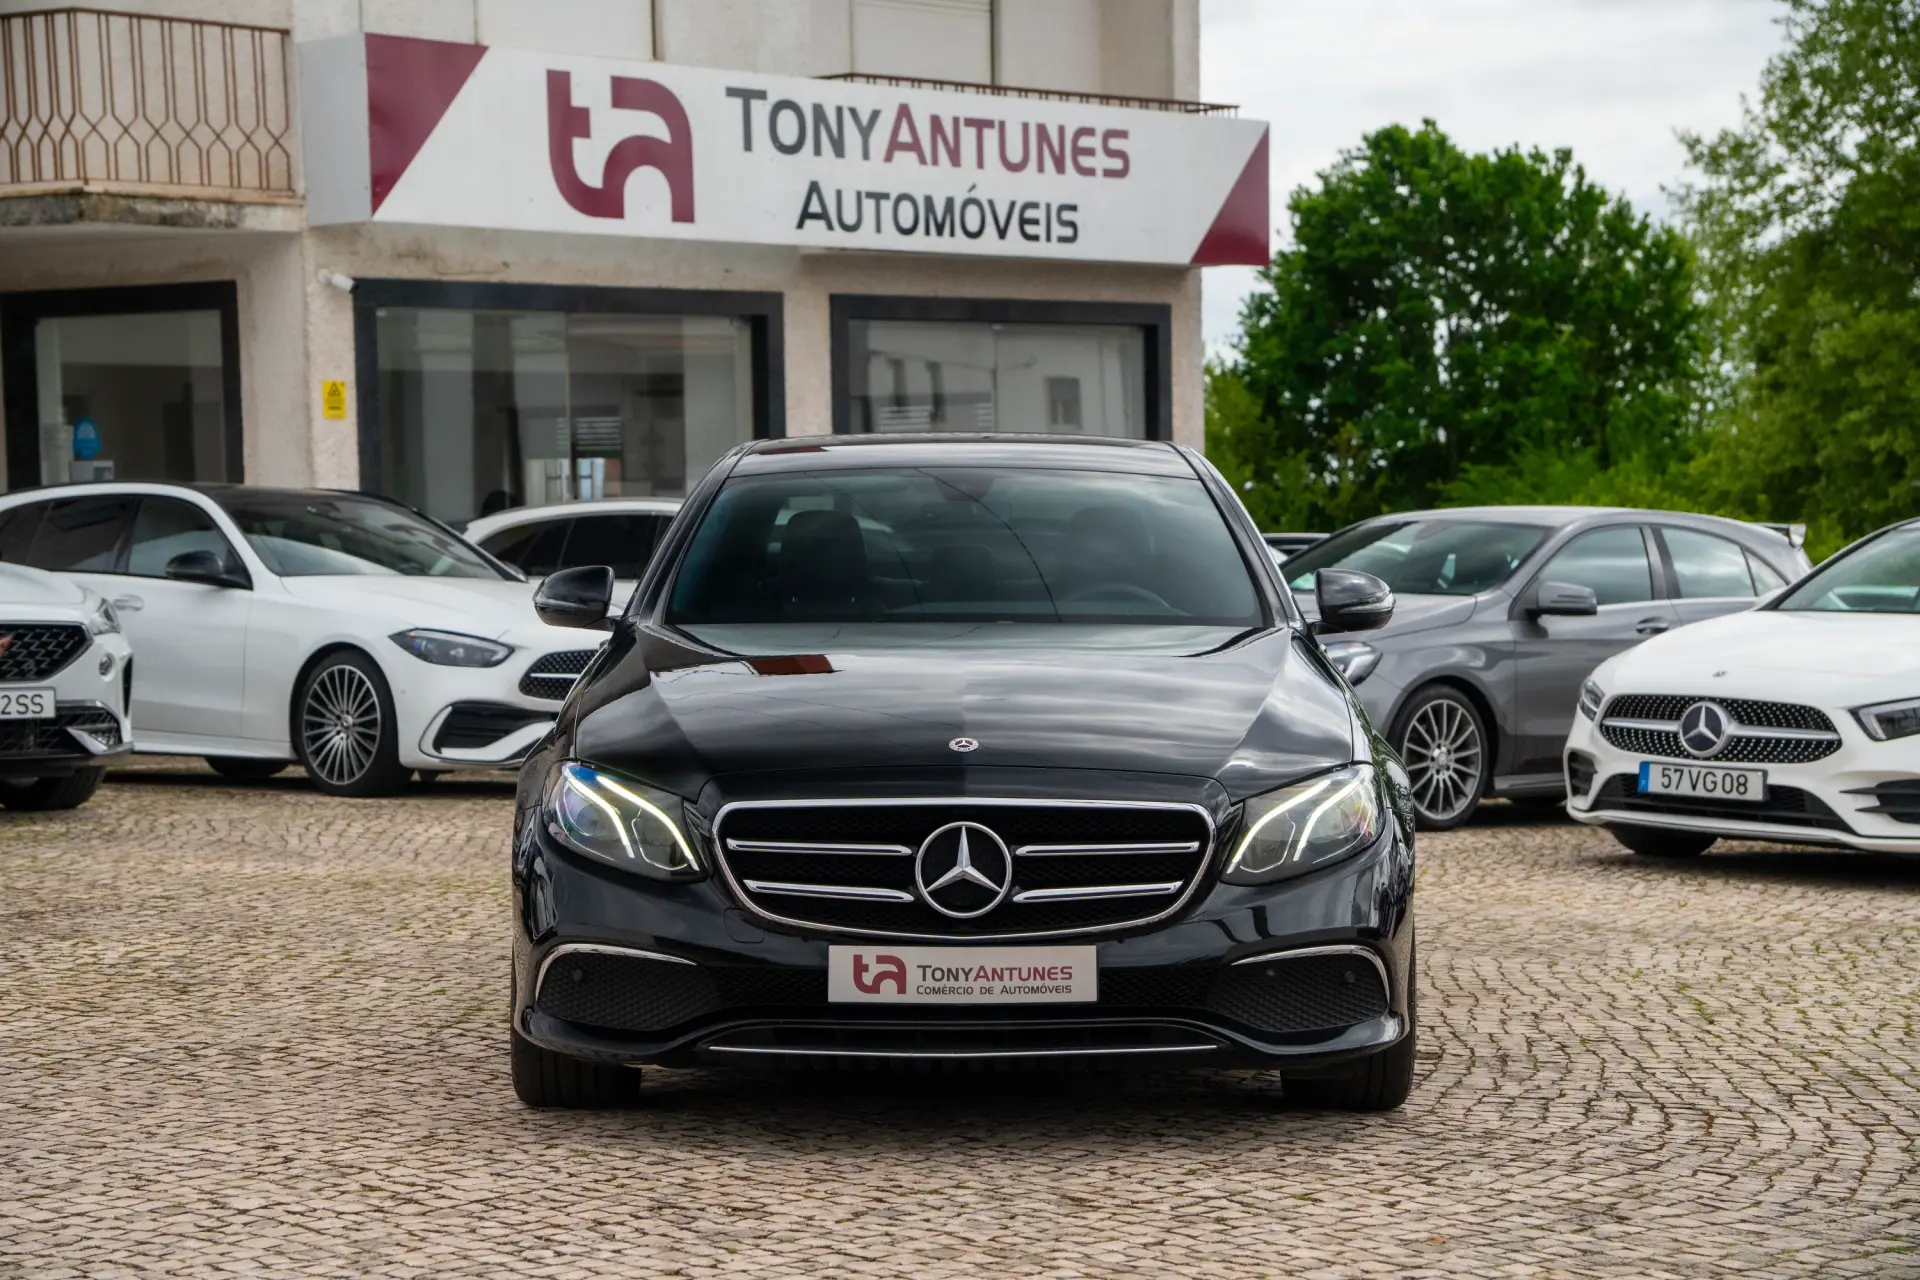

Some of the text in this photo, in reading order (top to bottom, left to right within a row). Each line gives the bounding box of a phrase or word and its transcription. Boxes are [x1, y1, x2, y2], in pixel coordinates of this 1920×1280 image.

[796, 180, 1080, 244] AUTOMÓVEIS
[916, 983, 1072, 996] COMÉRCIO DE AUTOMÓVEIS
